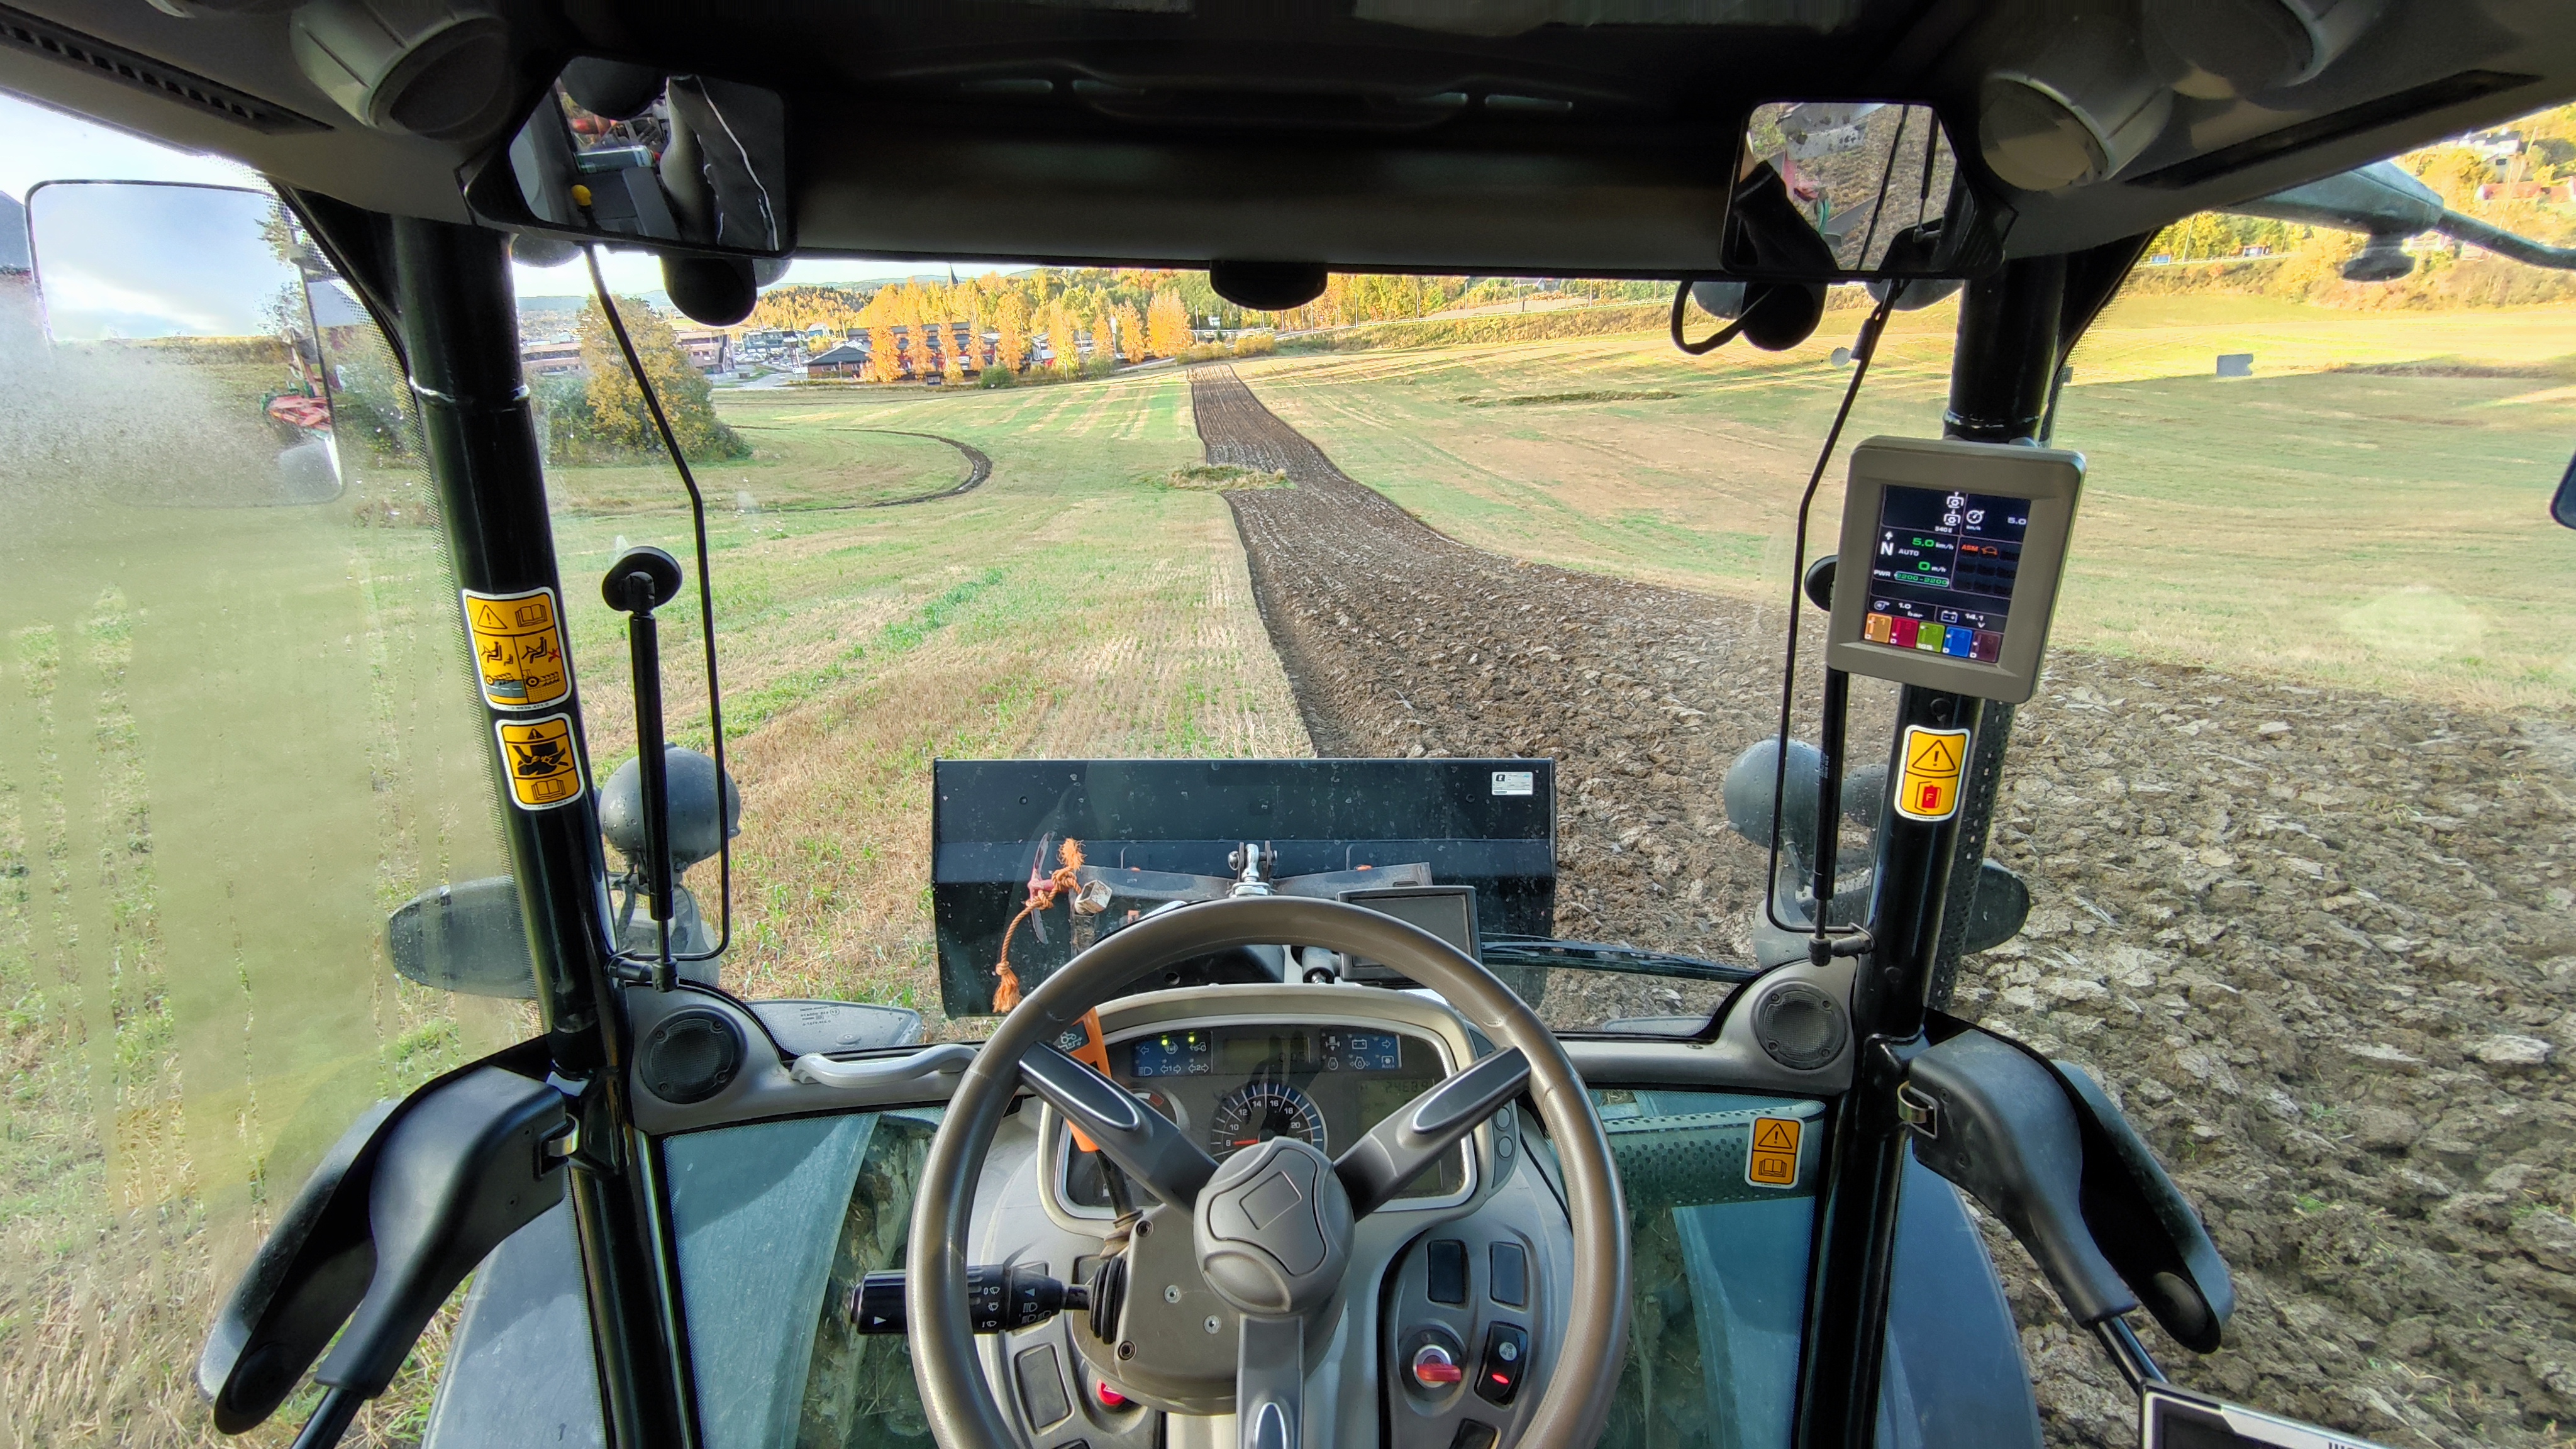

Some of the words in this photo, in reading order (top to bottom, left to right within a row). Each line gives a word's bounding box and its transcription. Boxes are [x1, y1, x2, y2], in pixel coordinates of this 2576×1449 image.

[2007, 516, 2027, 525] 5.0
[1912, 537, 1935, 547] 5.0
[1935, 542, 1954, 550] km/h
[1961, 544, 1979, 552] ASM
[1880, 541, 1894, 556] N
[1898, 548, 1919, 557] AUTO
[1918, 561, 1931, 571] 0
[1874, 569, 1891, 577] PWR
[1965, 613, 1984, 621] 14.1
[1925, 793, 1935, 802] F
